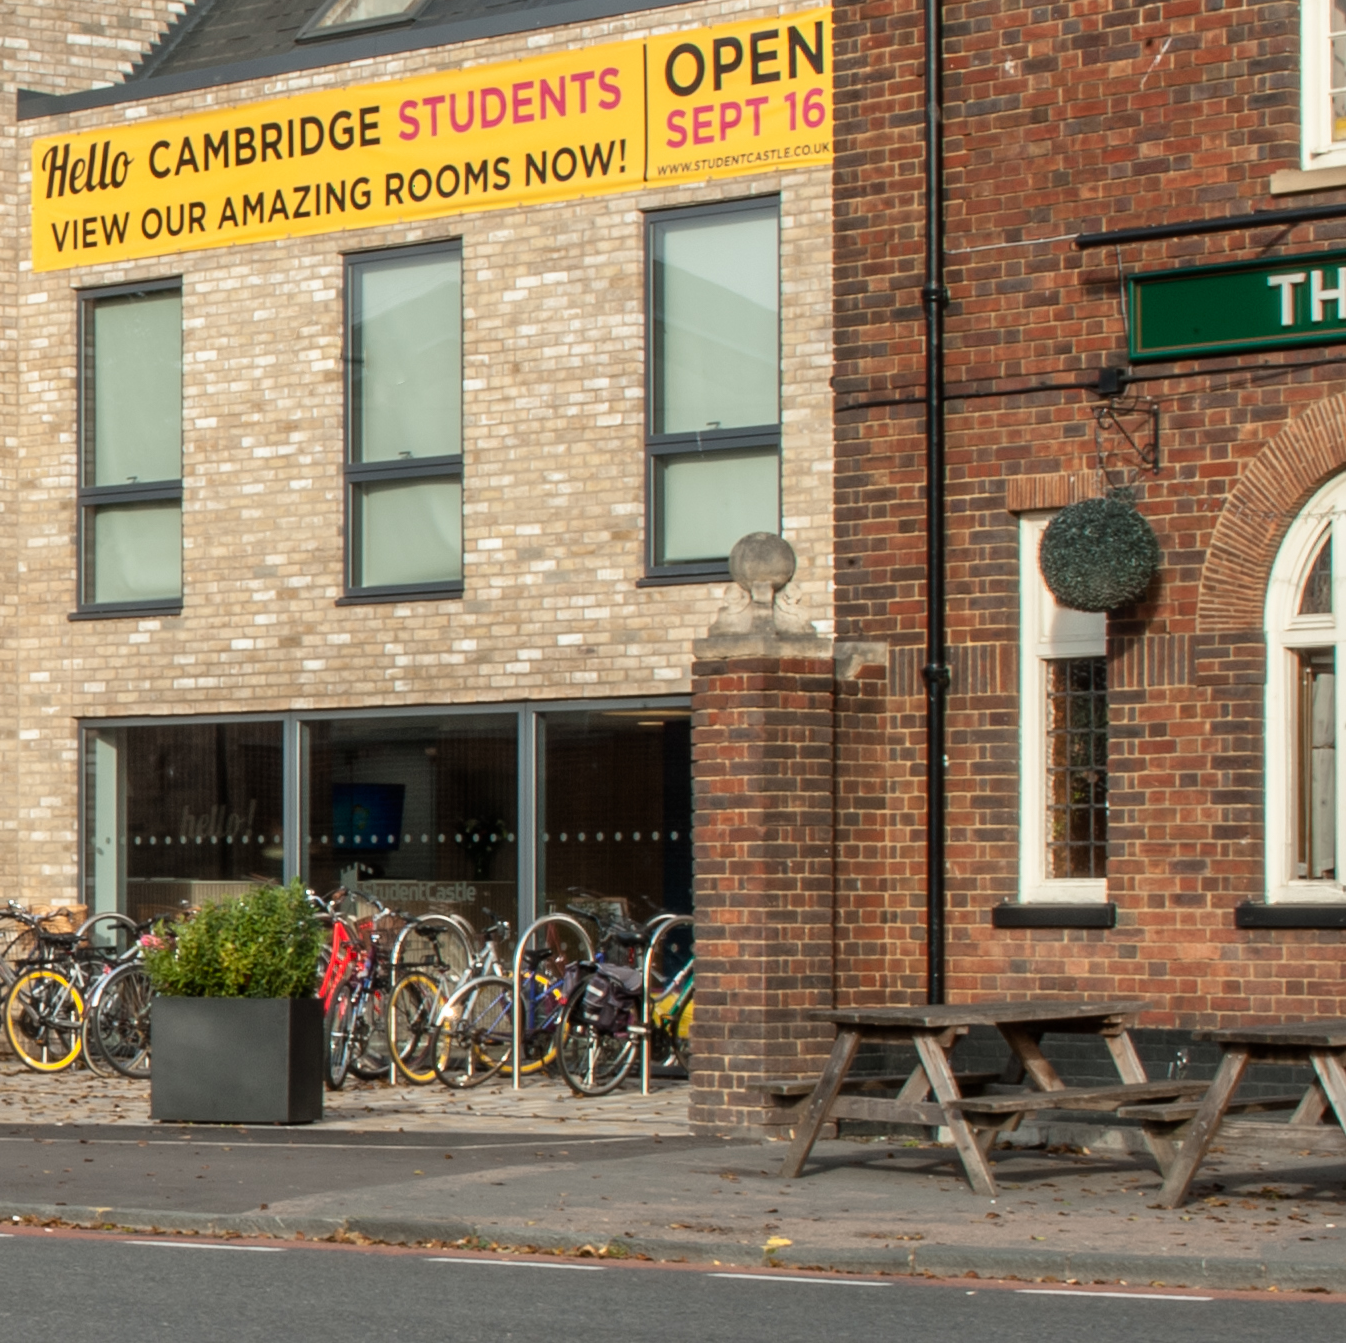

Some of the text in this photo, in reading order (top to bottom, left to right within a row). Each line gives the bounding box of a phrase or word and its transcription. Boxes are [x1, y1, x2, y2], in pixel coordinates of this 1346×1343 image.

[665, 21, 824, 97] OPEN
[42, 67, 622, 199] Hello CAMBRIDGE STUDENTS
[666, 87, 826, 148] SEPT 16
[657, 142, 830, 176] WWW.STUDENTCASTLE.CO.UK
[51, 139, 626, 252] VIEW OUR AMAZING ROOMS NOW!
[1267, 267, 1346, 326] TH
